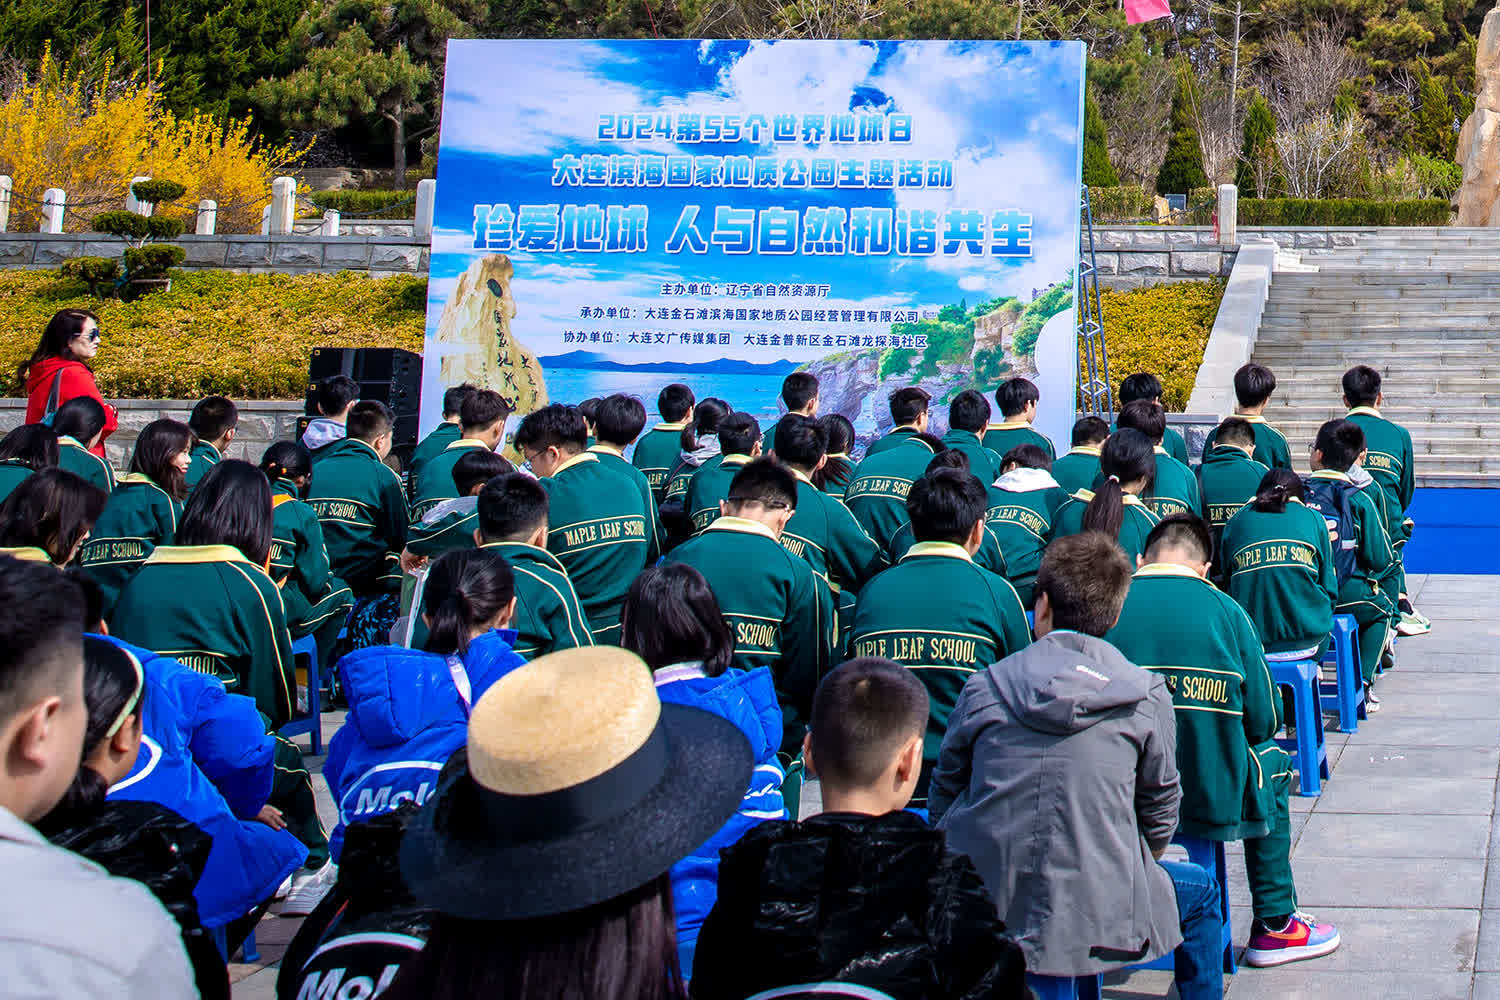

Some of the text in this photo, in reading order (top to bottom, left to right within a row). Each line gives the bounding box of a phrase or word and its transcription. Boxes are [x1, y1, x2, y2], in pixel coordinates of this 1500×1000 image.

[596, 112, 913, 144] 2024第55个世界地球日
[551, 154, 954, 190] 大连滨海国家地质公园主题活动
[473, 203, 1033, 258] 珍爱地球 人与自然和谐共生
[743, 333, 928, 348] 大连金普新区金石滩龙探海社区
[869, 479, 892, 492] LEAF
[328, 503, 358, 520] SCHOOL
[997, 508, 1019, 520] LEAF
[1019, 511, 1044, 535] SCHOOL
[564, 525, 597, 547] MAPLE
[600, 521, 621, 540] LEAF
[90, 544, 110, 561] LEAF
[111, 542, 145, 558] SCHOOL
[1236, 547, 1315, 569] MAPLE LEAF SCHOOL
[736, 622, 778, 648] SCHOOL
[892, 636, 925, 661] LEAF
[930, 637, 977, 664] SCHOOL
[1182, 675, 1229, 704] SCHOOL
